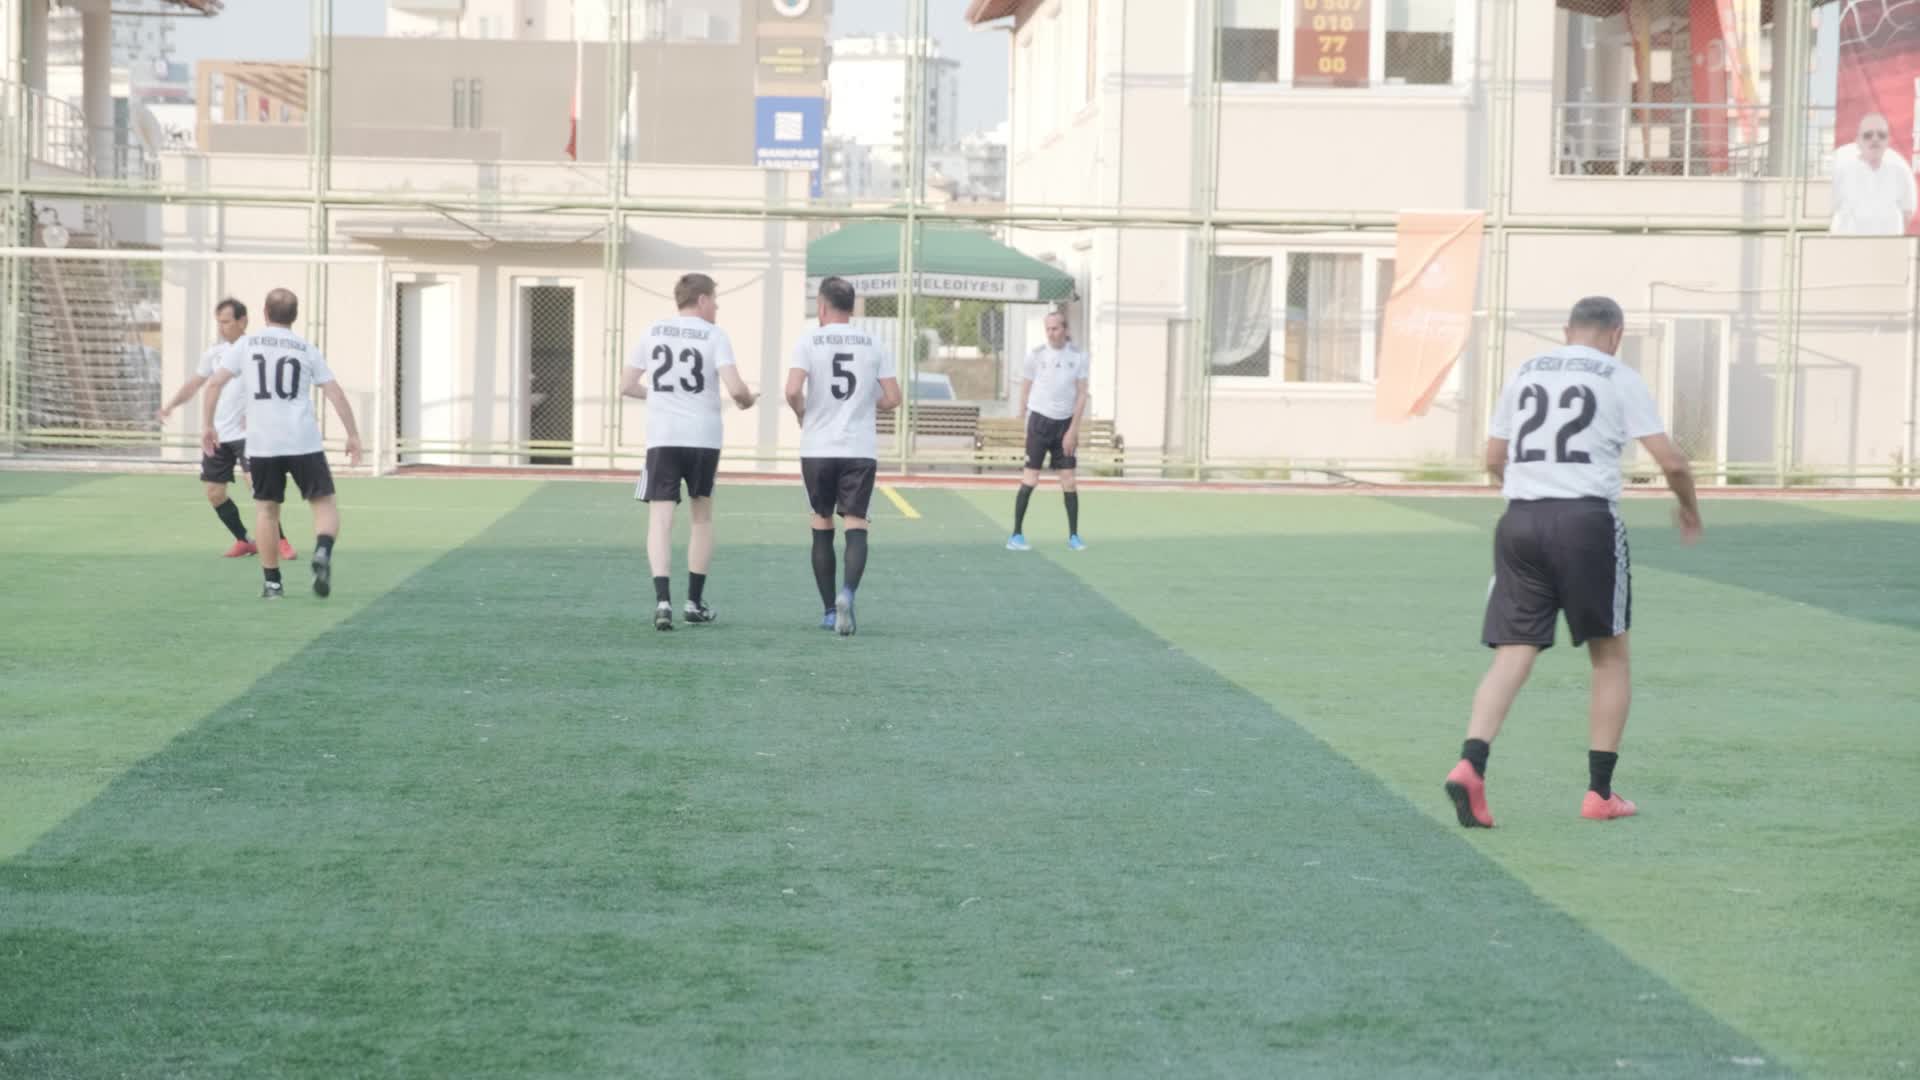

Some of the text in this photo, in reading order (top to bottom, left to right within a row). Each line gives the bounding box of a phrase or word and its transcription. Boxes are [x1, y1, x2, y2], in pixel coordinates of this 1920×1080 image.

[1318, 35, 1347, 53] 77
[252, 353, 302, 401] 10
[652, 344, 705, 394] 23
[831, 353, 857, 401] 5
[1514, 384, 1597, 464] 22
